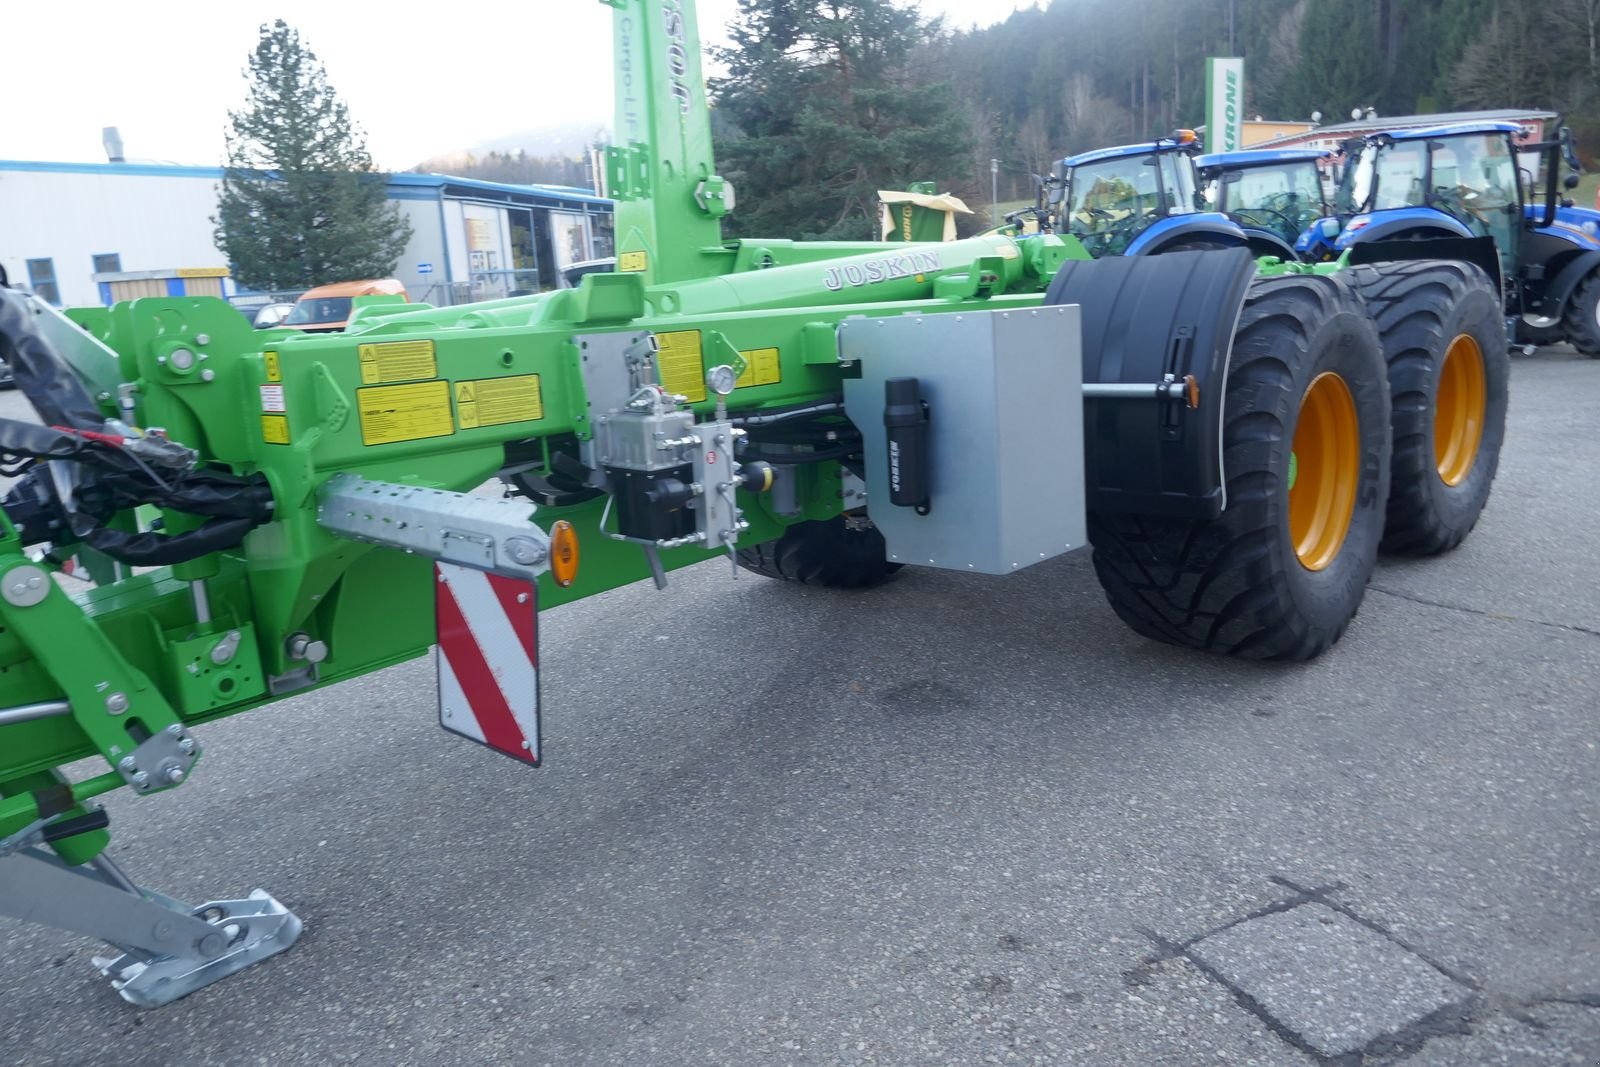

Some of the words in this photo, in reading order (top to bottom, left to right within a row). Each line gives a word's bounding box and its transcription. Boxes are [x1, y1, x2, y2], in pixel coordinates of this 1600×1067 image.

[619, 17, 639, 143] Cargo-LIF
[661, 0, 693, 115] JOS
[824, 251, 944, 292] JOSKIN
